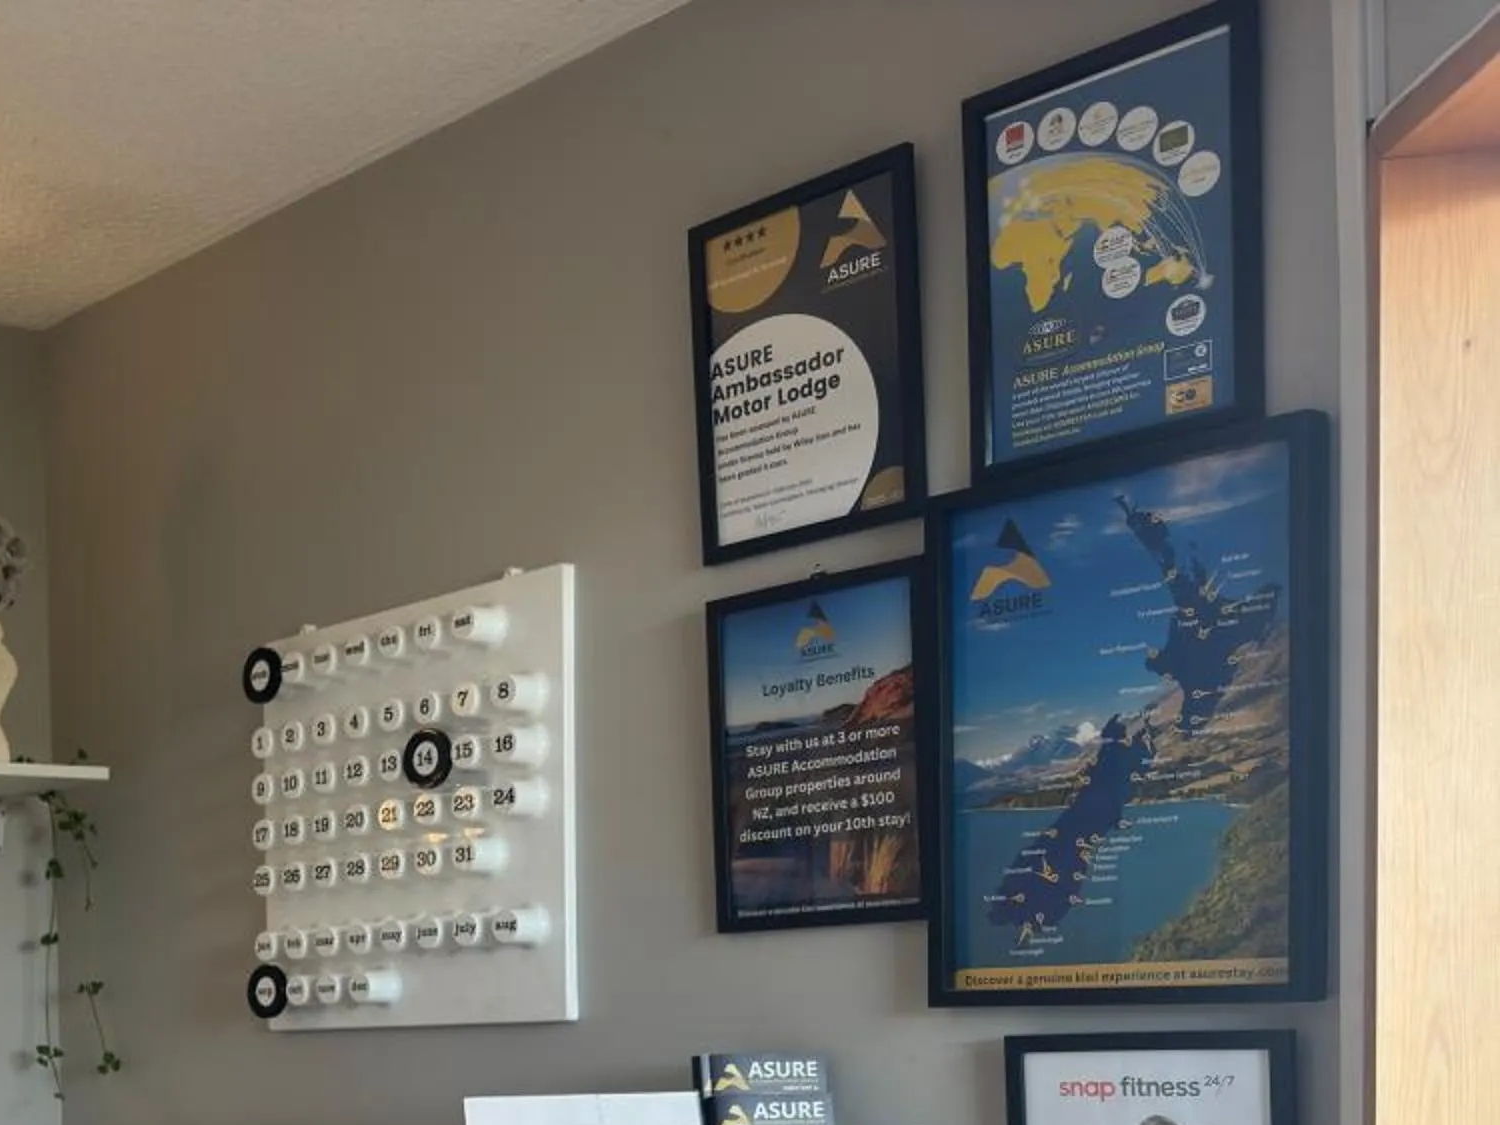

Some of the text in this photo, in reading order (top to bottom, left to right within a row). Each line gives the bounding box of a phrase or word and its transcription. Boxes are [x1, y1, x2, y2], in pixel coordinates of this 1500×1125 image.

[827, 252, 882, 283] ASURE
[712, 344, 772, 379] ASURE
[713, 348, 844, 401] Ambassador
[713, 374, 840, 424] Motor Lodge
[978, 591, 1044, 618] ASURE
[761, 665, 875, 698] Loyalty Benefits
[256, 681, 509, 750] 1 2 3 4 5 6 7 8
[745, 724, 900, 759] Stay with us at 3 or more
[257, 733, 513, 797] 9 10 11 12 13 14 15 16
[748, 747, 897, 778] ASURE Accommodation
[745, 768, 900, 801] Group properties around
[255, 787, 515, 843] 17 18 19 20 21 22 23 24
[752, 807, 773, 820] NZ,
[775, 804, 800, 818] and
[801, 797, 848, 815] receive
[861, 791, 895, 807] $100
[739, 827, 792, 843] discount
[795, 823, 811, 835] on
[813, 820, 842, 837] your
[845, 816, 875, 831] 10th
[255, 845, 474, 887] 25 26 27 28 29 30 31
[965, 974, 1013, 986] Discover
[1017, 975, 1023, 984] a
[1026, 974, 1072, 987] genuine
[1102, 968, 1171, 984] experience
[1174, 970, 1185, 980] at
[748, 1061, 818, 1078] ASURE
[1059, 1075, 1235, 1101] snap fitness 24/7
[753, 1101, 825, 1119] ASURE
